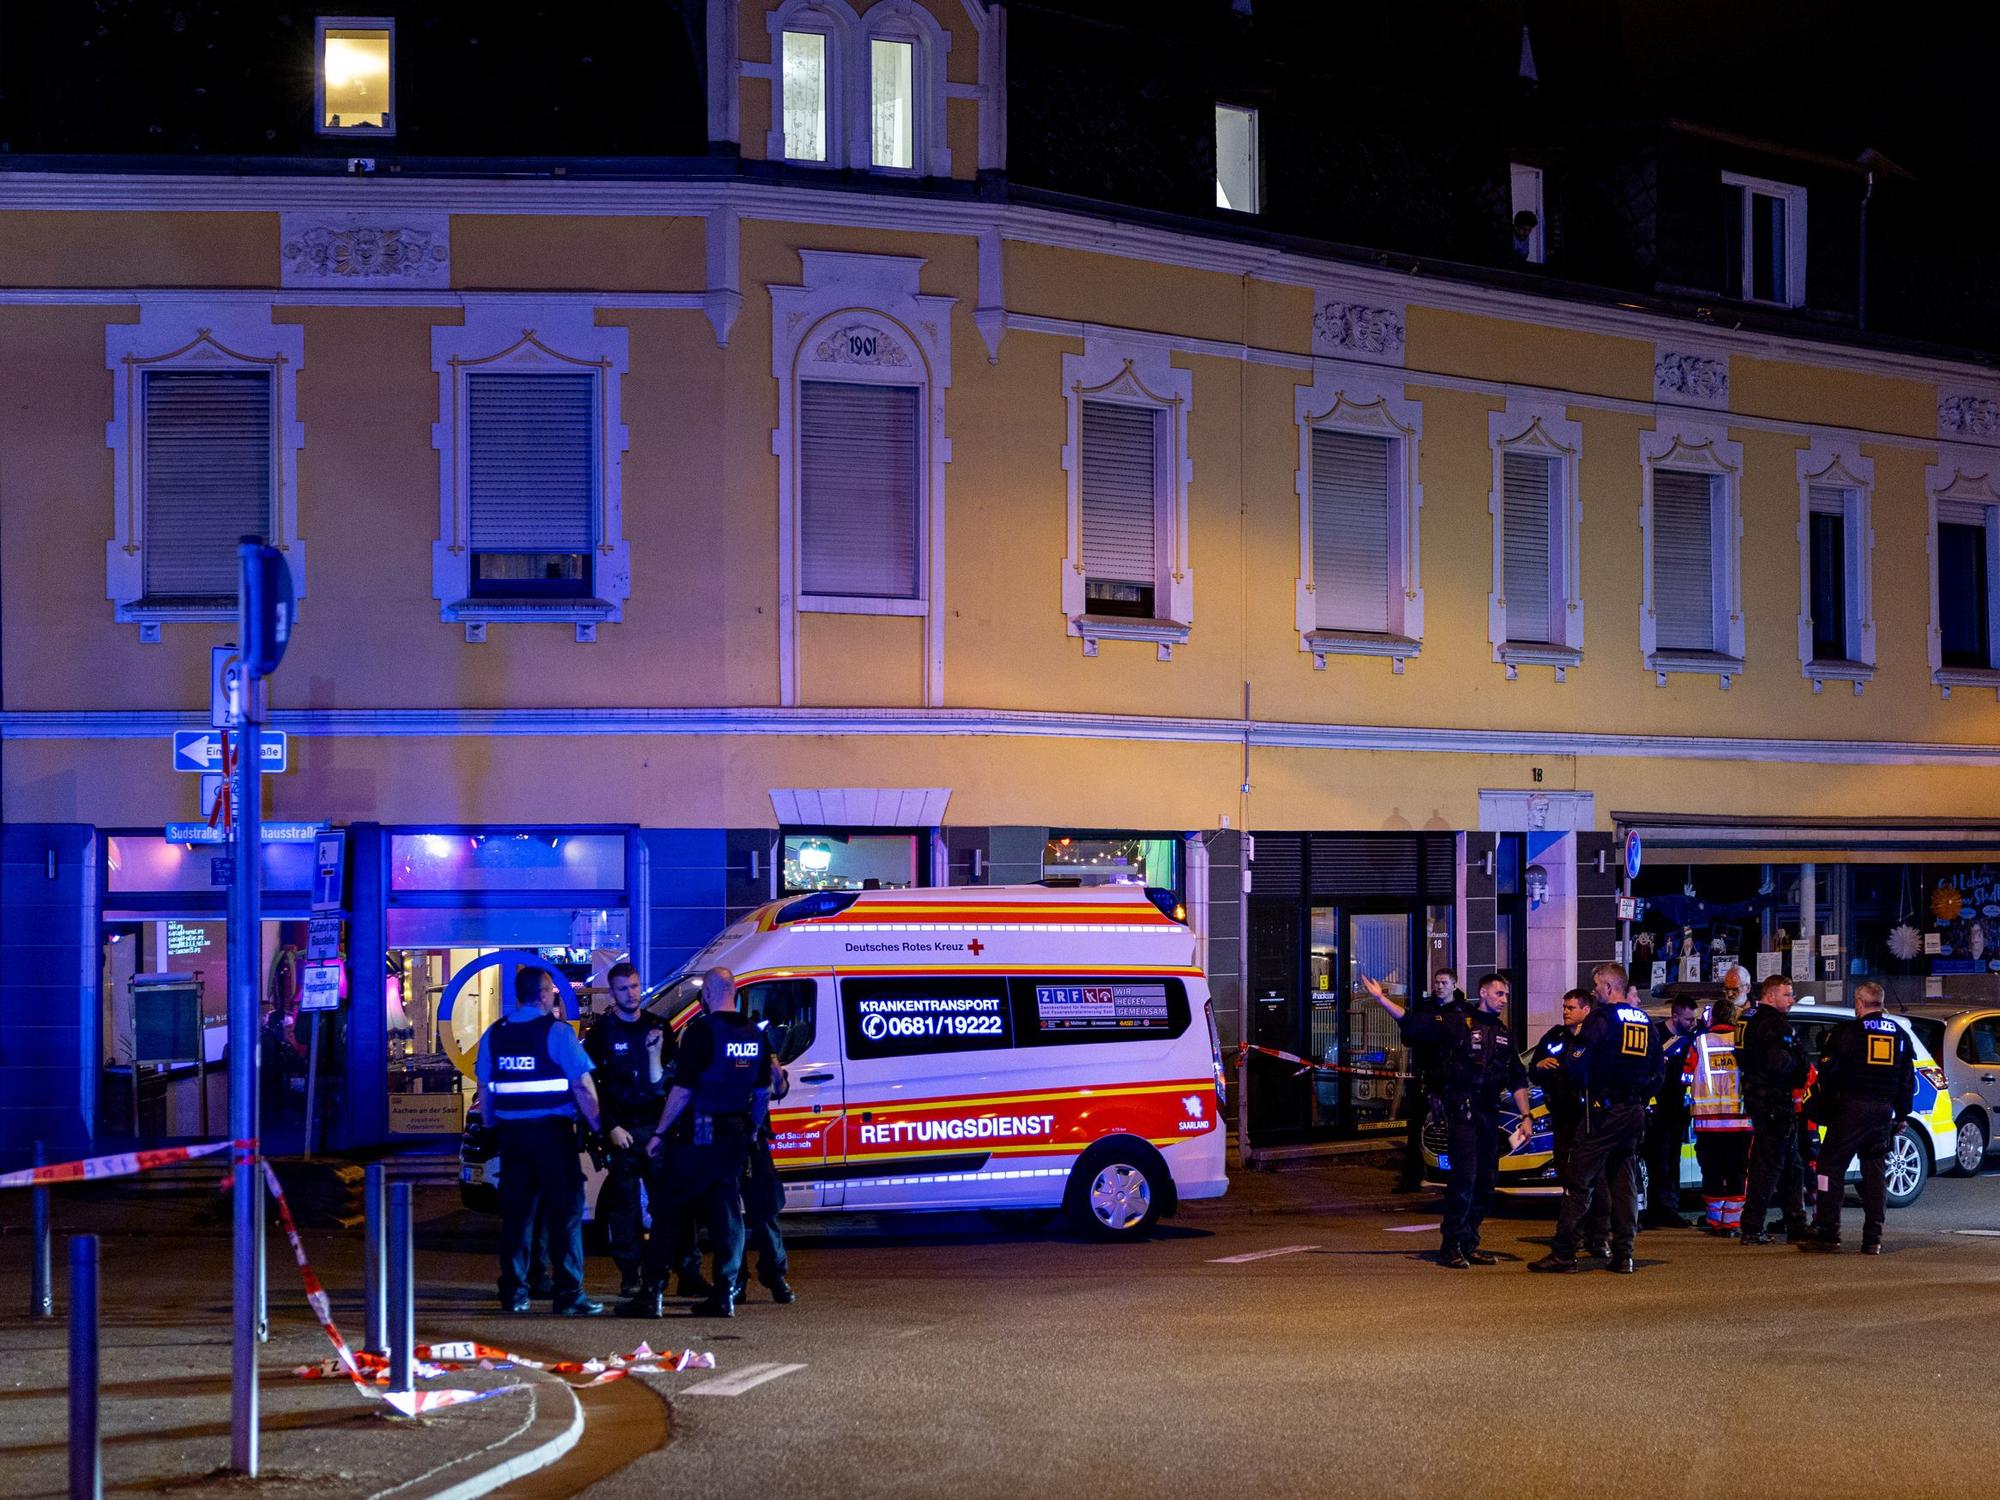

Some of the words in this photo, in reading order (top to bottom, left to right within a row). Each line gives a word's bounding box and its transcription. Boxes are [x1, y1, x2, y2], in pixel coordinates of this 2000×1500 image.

[850, 336, 877, 356] 1901
[1532, 767, 1543, 782] 18
[845, 943, 900, 952] Deutsches
[902, 942, 932, 951] Rotes
[934, 942, 964, 951] Kreuz
[1433, 939, 1442, 949] 18
[1827, 961, 1835, 970] 18
[860, 1000, 1000, 1012] KRANKENTRANSPORT
[1117, 997, 1146, 1005] HELFEN
[888, 1016, 1003, 1035] 0681/19222
[1863, 1020, 1897, 1032] POLIZEI
[727, 1043, 759, 1057] POLIZEI
[499, 1057, 535, 1070] POLIZEI
[861, 1115, 1054, 1144] RETTUNGSDIENST
[1178, 1120, 1209, 1130] SAARLAND
[786, 1130, 820, 1140] Saarland
[777, 1140, 811, 1149] Sulzbach
